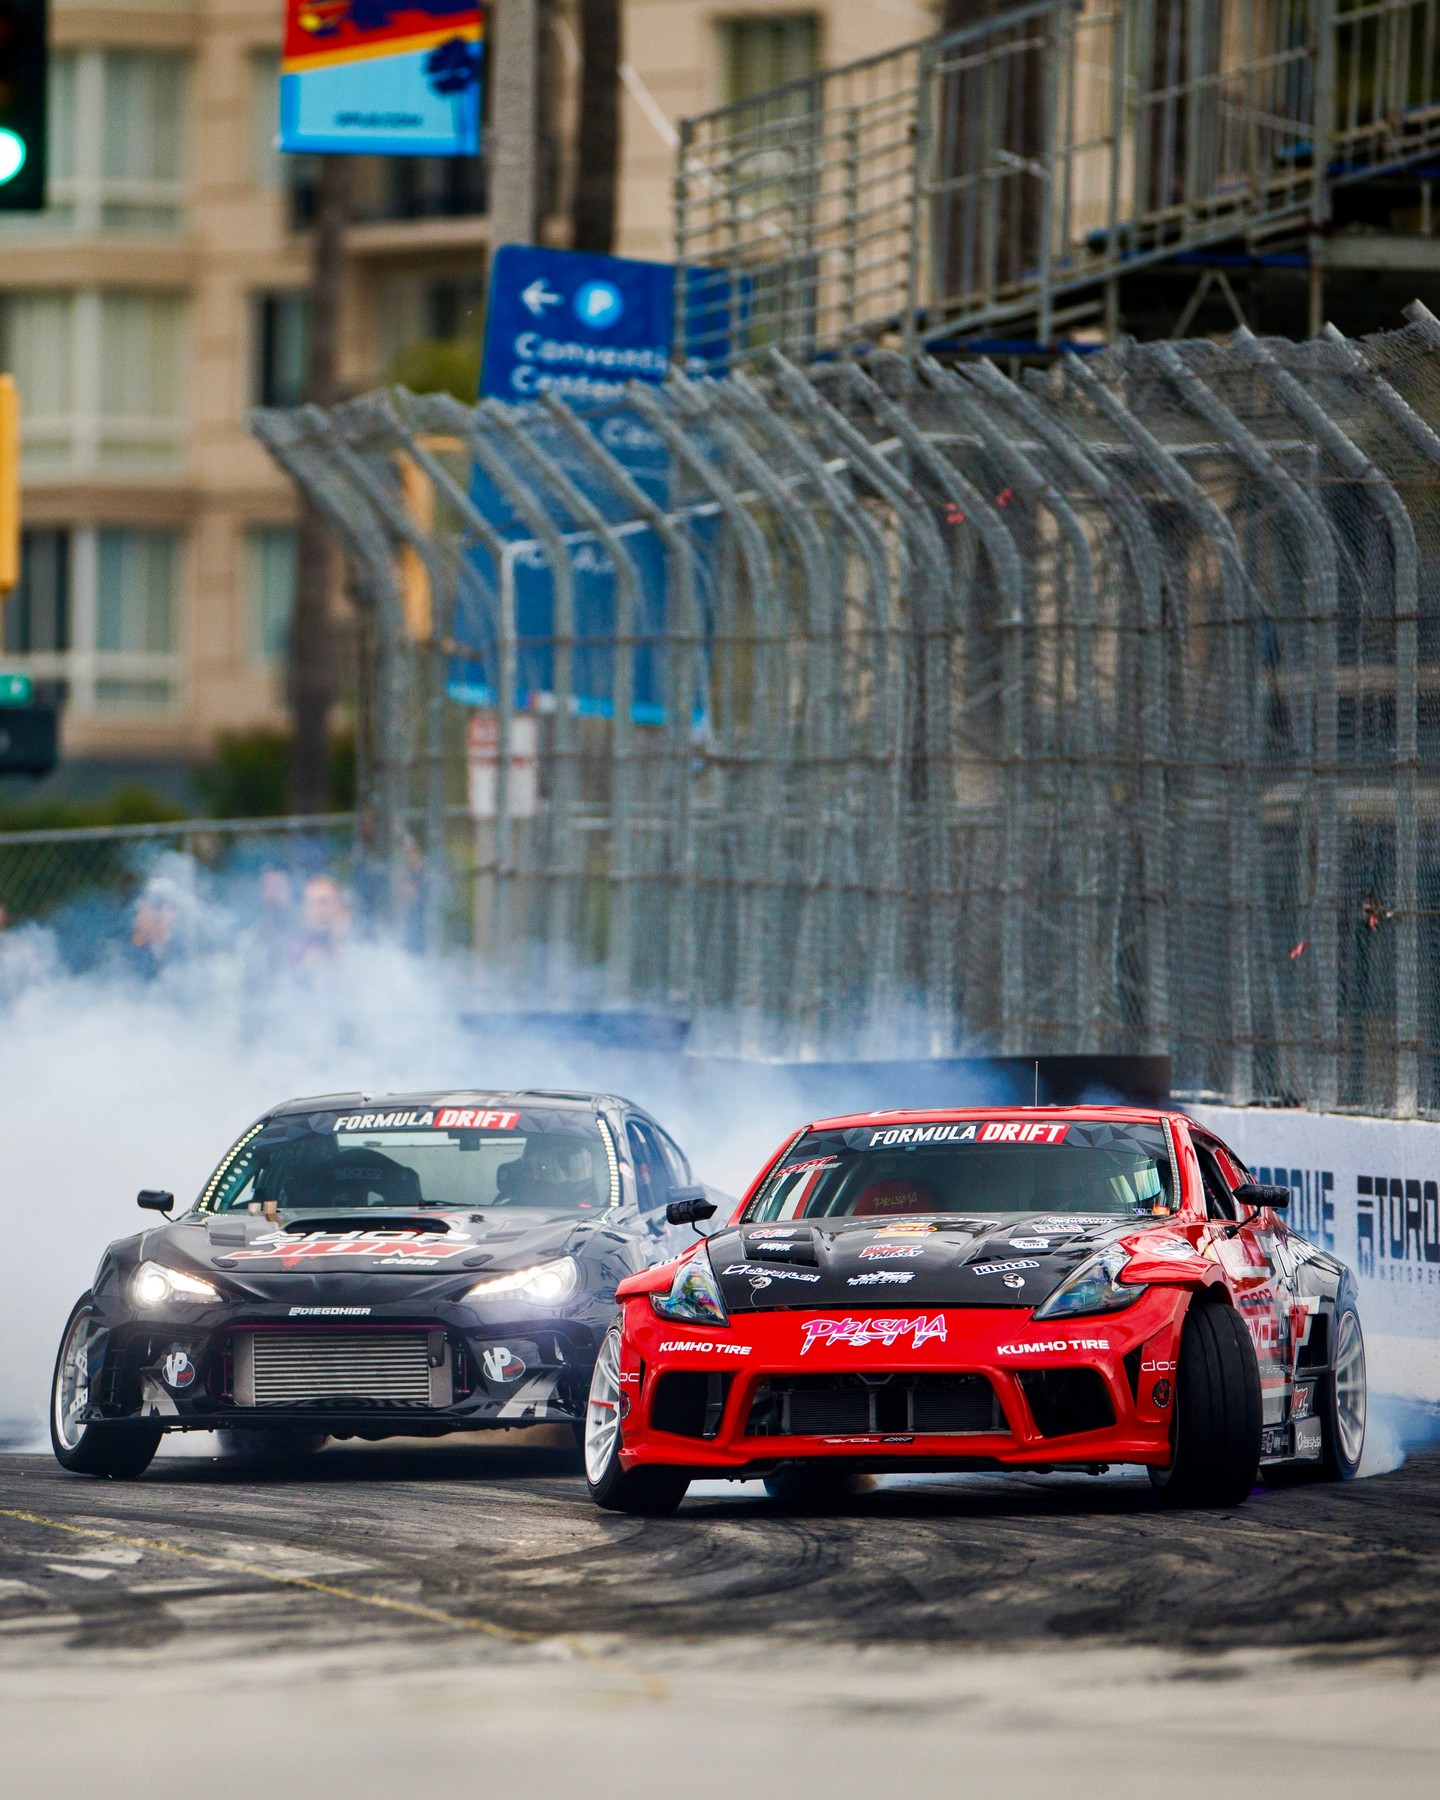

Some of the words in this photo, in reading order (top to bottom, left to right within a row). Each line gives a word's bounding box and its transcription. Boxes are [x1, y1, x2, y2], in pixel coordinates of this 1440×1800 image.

[333, 1111, 434, 1132] FORMULA
[438, 1109, 516, 1129] DRIFT
[869, 1125, 977, 1147] FORMULA
[981, 1123, 1065, 1142] DRIFT
[249, 1230, 472, 1245] SHOP
[221, 1241, 480, 1259] JDM
[372, 1257, 439, 1266] .com
[288, 1306, 372, 1317] @DIEGOHIGA
[800, 1314, 948, 1355] PRISMA
[658, 1341, 713, 1353] KUMHO
[715, 1343, 752, 1355] TIRE
[997, 1340, 1067, 1355] KUMHO
[1068, 1339, 1110, 1350] TIRE
[167, 1351, 188, 1387] VP
[482, 1346, 512, 1382] VP
